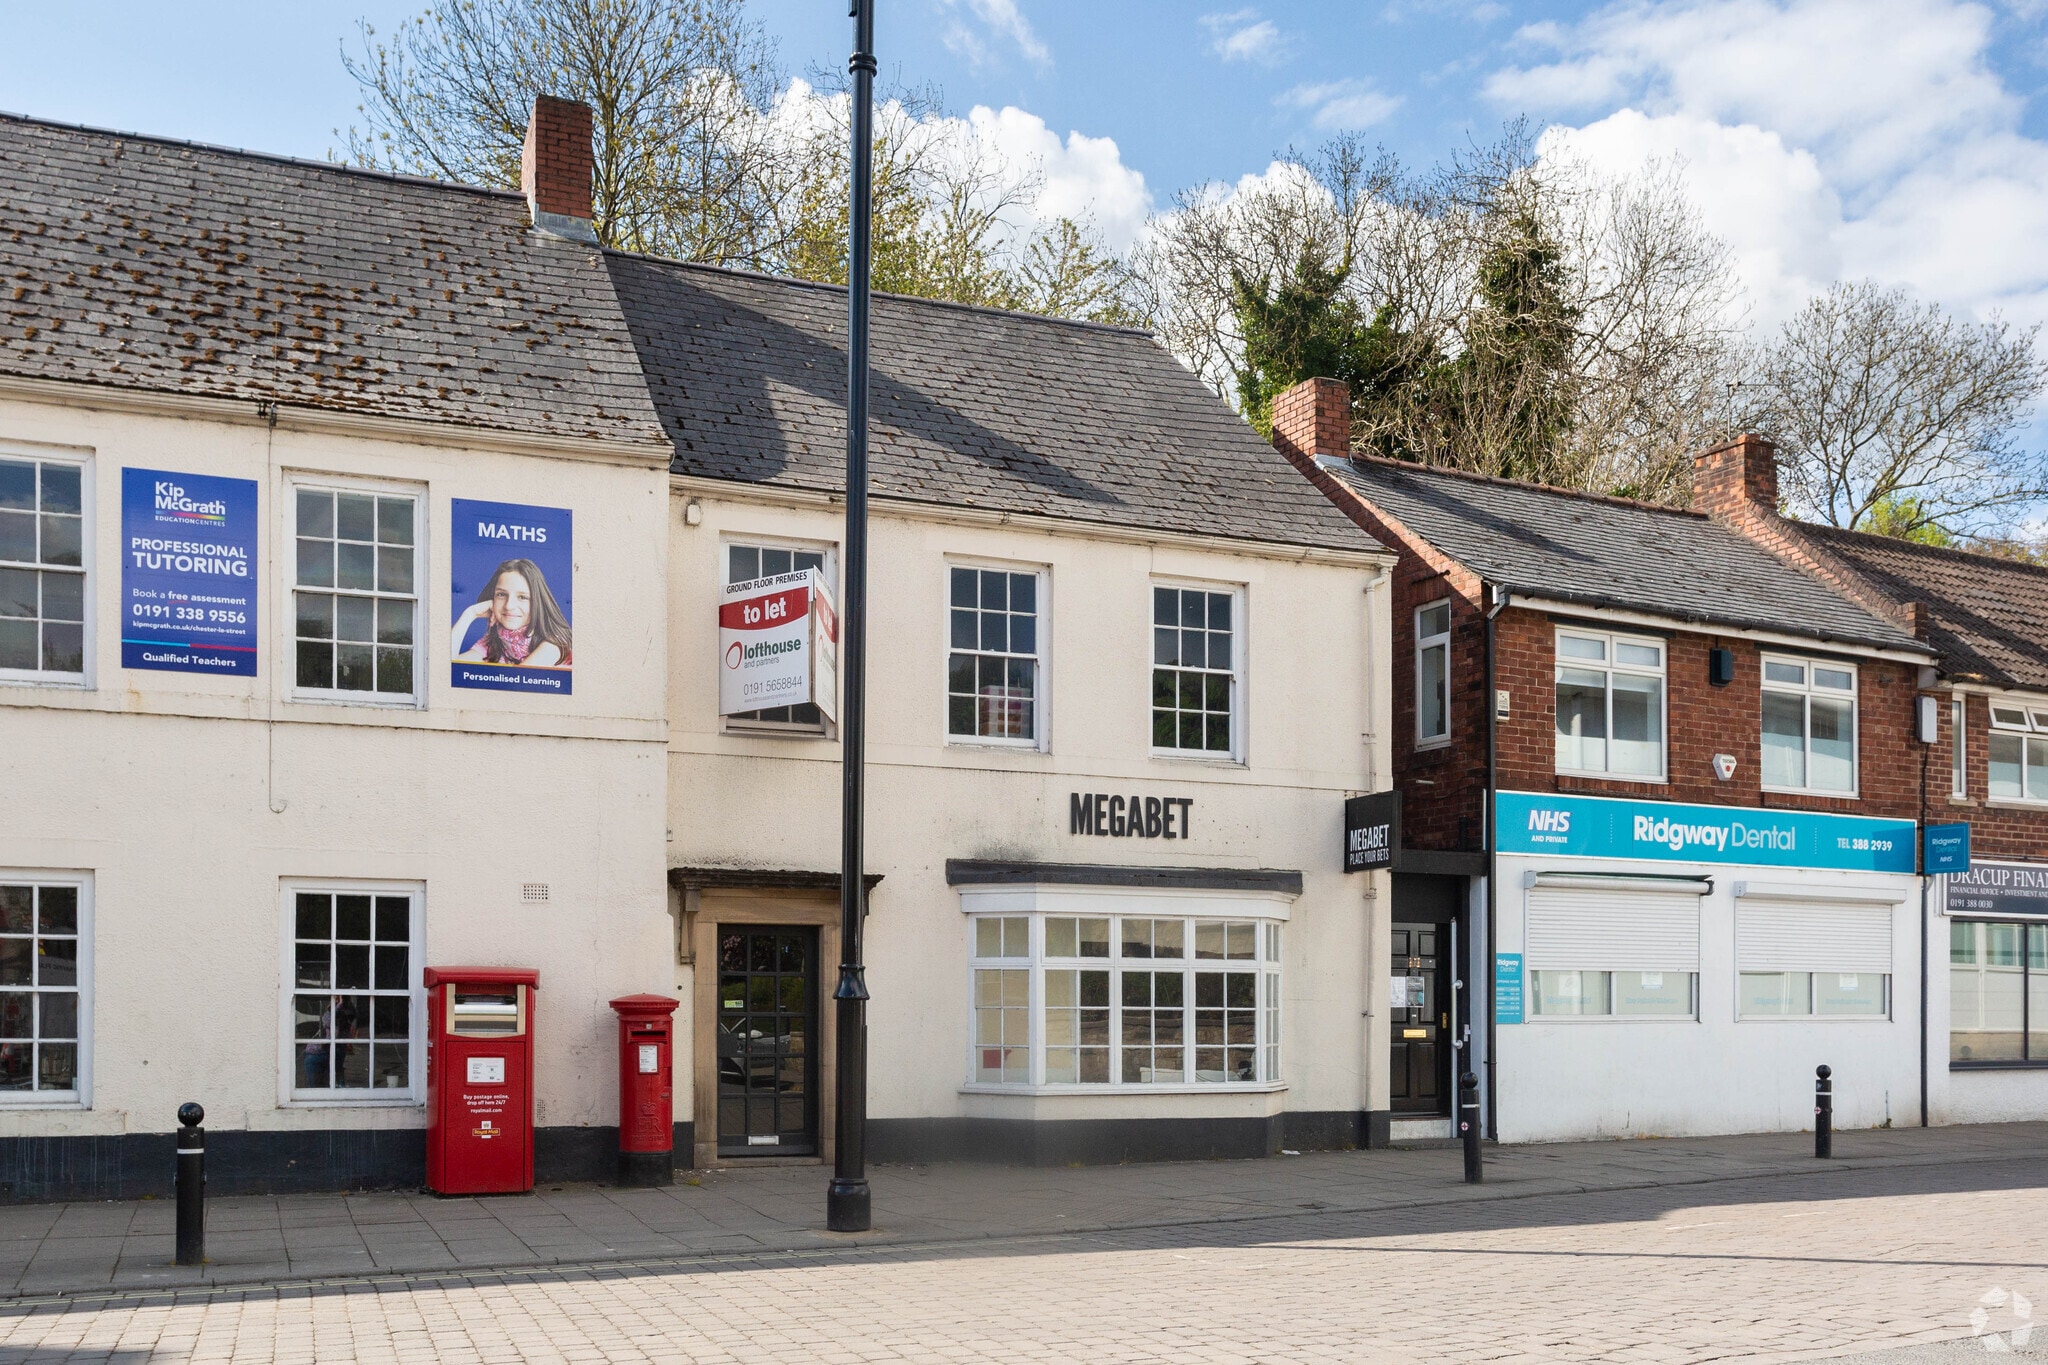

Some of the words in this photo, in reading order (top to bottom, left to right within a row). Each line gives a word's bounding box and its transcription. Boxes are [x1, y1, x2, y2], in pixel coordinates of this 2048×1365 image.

[155, 481, 185, 501] Kip
[155, 495, 226, 515] McGrath
[478, 522, 547, 543] MATHS
[132, 537, 248, 559] PROFESSIONAL
[132, 551, 248, 577] TUTORING
[726, 581, 752, 594] GROUND
[753, 578, 773, 589] FLOOR
[775, 571, 808, 585] PREMISES
[132, 588, 157, 599] Book
[168, 590, 188, 601] free
[191, 594, 246, 606] assessment
[132, 603, 170, 618] 0191
[176, 606, 204, 620] 338
[209, 609, 246, 624] 9556
[743, 604, 761, 625] to
[764, 597, 787, 620] let
[132, 620, 246, 635] kipmcgrath.co.uk/chester-le-street
[744, 638, 802, 660] lofthouse
[142, 652, 189, 664] Qualified
[192, 655, 236, 667] Teachers
[743, 658, 755, 669] and
[755, 656, 780, 669] partners
[463, 671, 520, 684] Personalised
[522, 673, 561, 688] Learning
[743, 681, 763, 696] 0191
[766, 675, 802, 692] 5658844
[1070, 792, 1194, 839] MEGABET
[1528, 809, 1571, 832] NHS
[1350, 824, 1390, 852] MEGABET
[1545, 835, 1568, 844] PRIVATE
[1634, 815, 1729, 851] Ridgway
[1731, 822, 1796, 850] Dental
[1931, 837, 1962, 847] Ridgway
[1837, 837, 1851, 849] TEL
[1852, 838, 1869, 850] 388
[1871, 839, 1893, 852] 2939
[1350, 851, 1364, 866] PLACE
[1364, 850, 1377, 863] YOUR
[1376, 847, 1390, 862] BETS
[1950, 868, 2010, 886] DRACUP
[1950, 886, 1979, 895] FINANCIAL
[1980, 887, 1999, 896] ADVICE
[1950, 898, 1965, 908] 0191
[1966, 899, 1977, 908] 388
[1977, 900, 1993, 909] 0030
